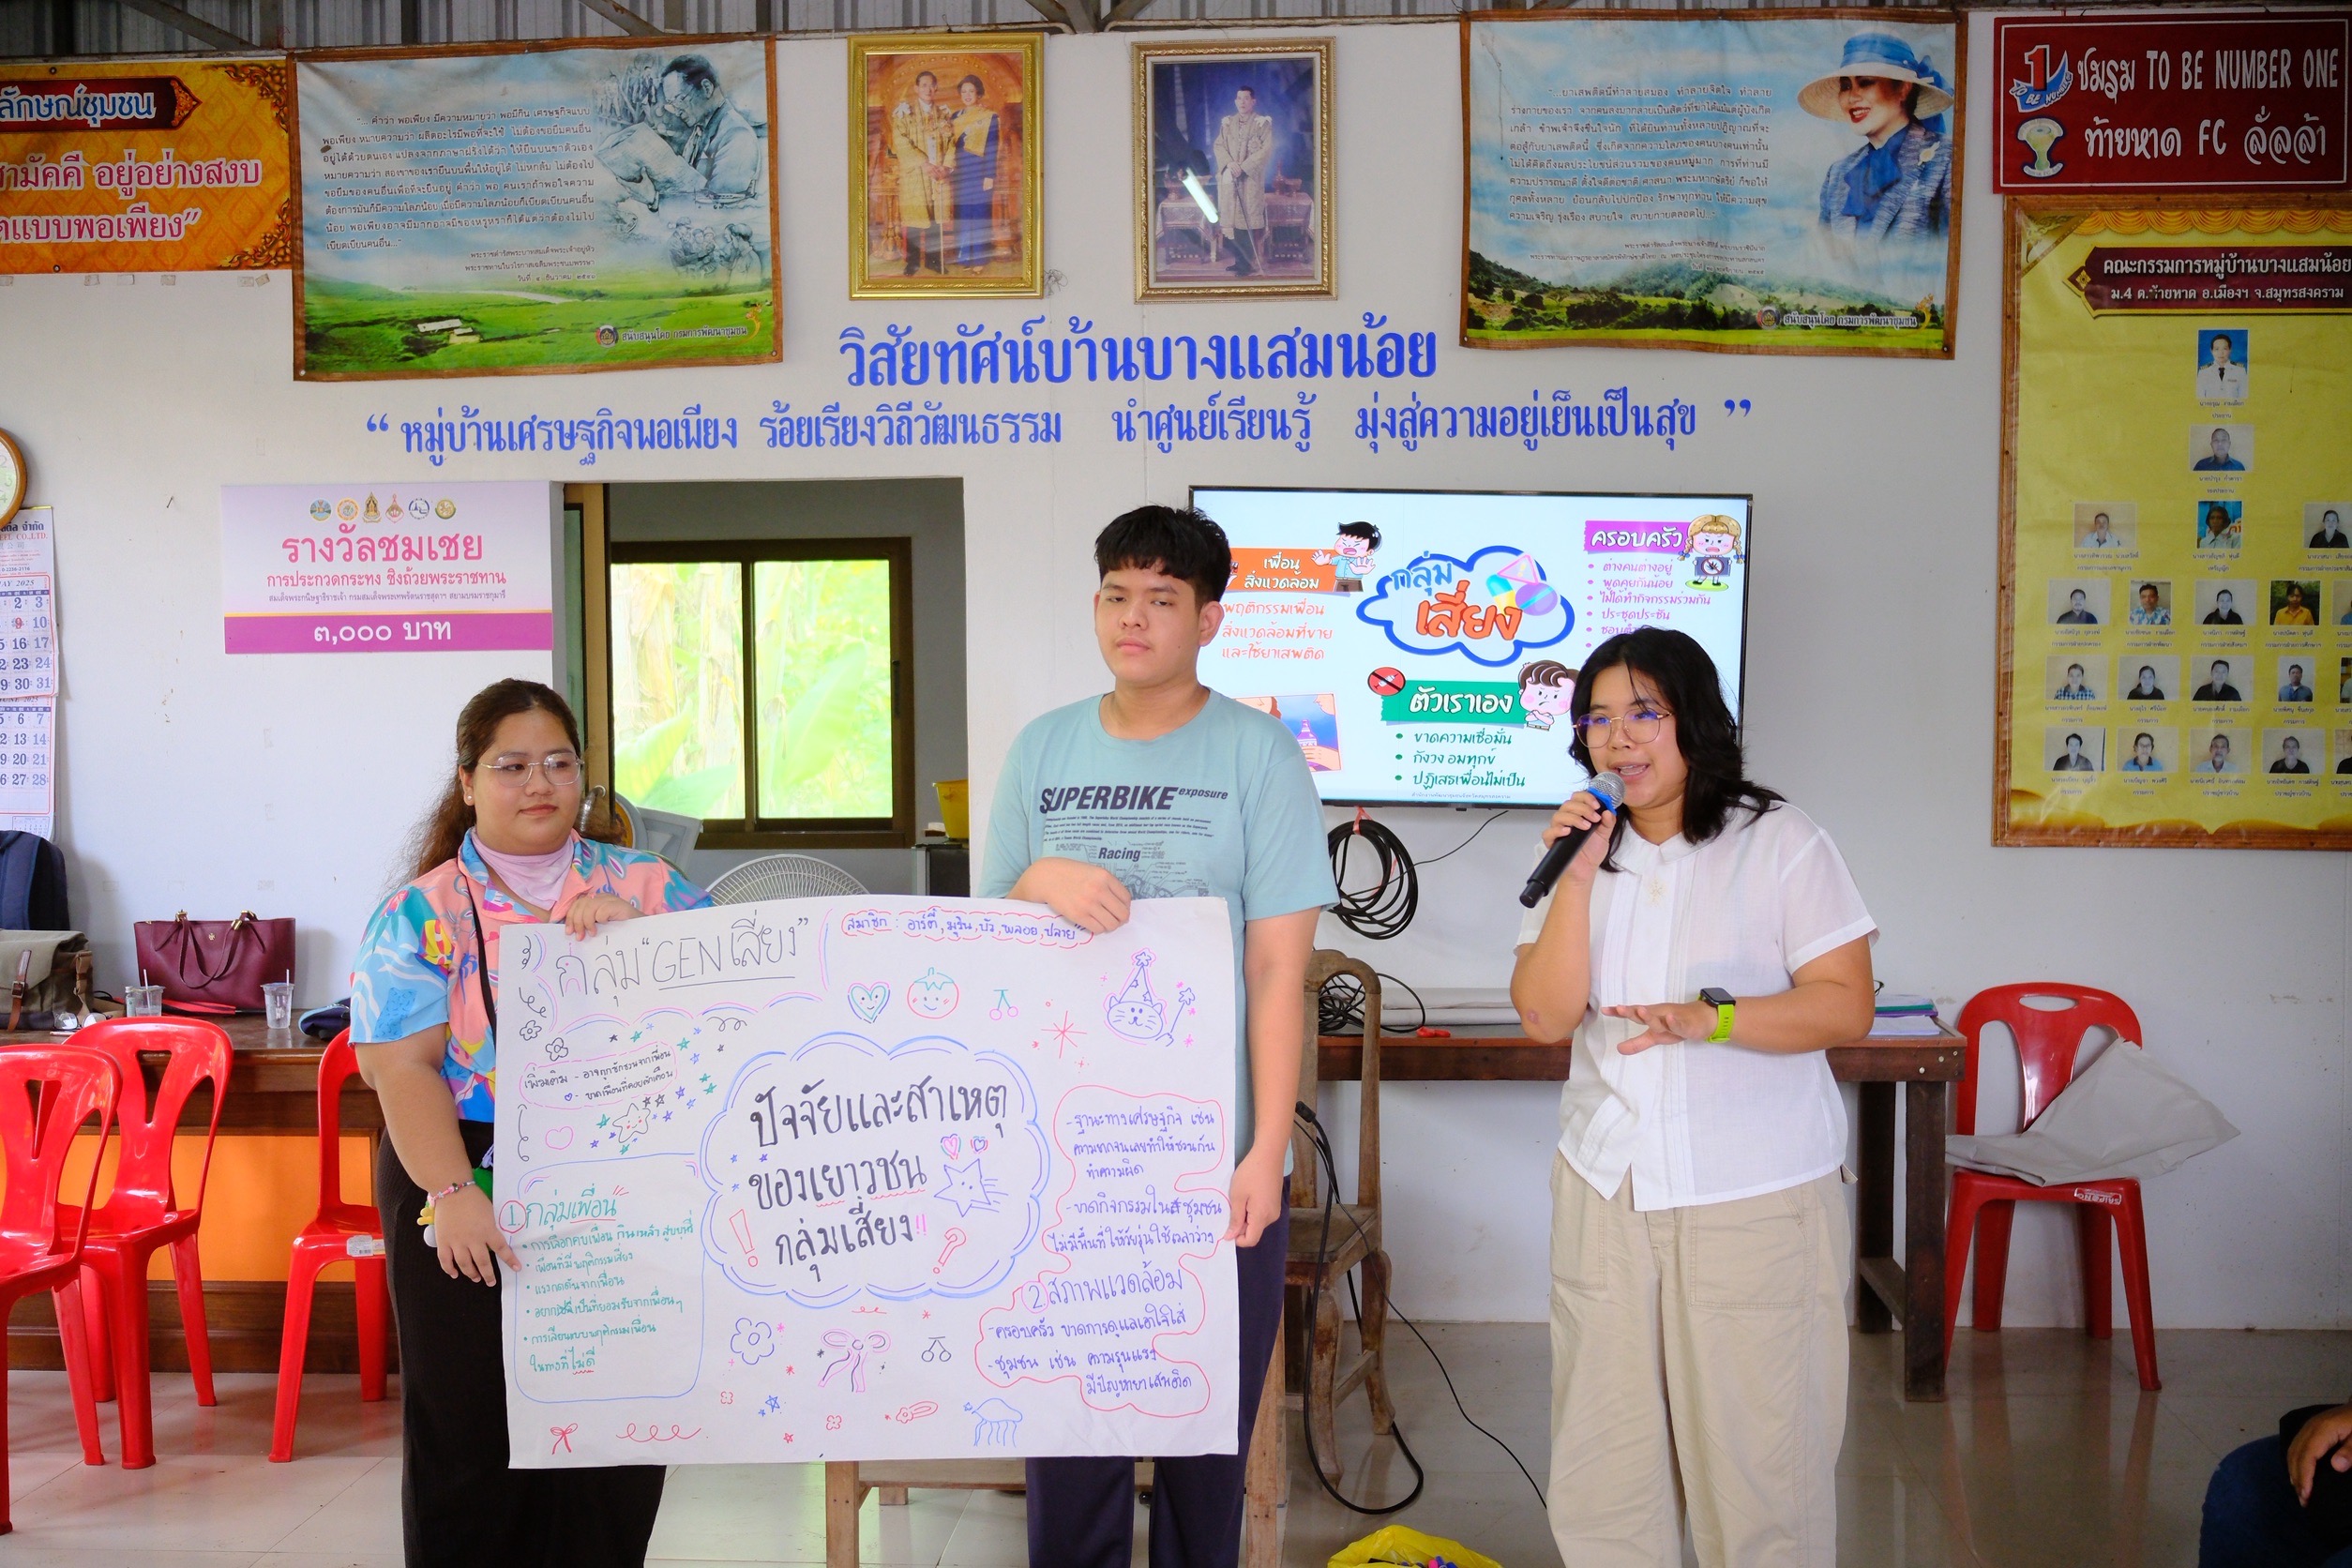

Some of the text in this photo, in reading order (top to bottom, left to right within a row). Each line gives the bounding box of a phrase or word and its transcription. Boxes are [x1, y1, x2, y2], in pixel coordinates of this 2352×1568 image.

[2147, 51, 2169, 90] TO
[2182, 51, 2202, 89] BE
[2216, 49, 2291, 89] NUMBER
[2303, 49, 2338, 87] ONE
[398, 113, 430, 125] พอเพียง
[434, 112, 496, 123] มีความหมายว่า
[534, 107, 590, 119] เศรษฐกิจแบบ
[323, 134, 355, 144] พอเพียง
[359, 130, 414, 143] หมายความว่า
[2085, 116, 2181, 158] ท้ายหาด
[2199, 119, 2226, 156] FC
[97, 152, 260, 196] อยู่อย่างสงบ
[324, 169, 381, 180] หมายความว่า
[2103, 253, 2351, 279] คณะกรรมการหมู่บ้านบางแสมน้อย
[2111, 284, 2344, 302] ม.4 ต.้ายหาด อ.เมืองฯ จ.สมุทรสงคราม
[838, 313, 1436, 386] วิสัยทัศน์บ้านบางแสมน้อย
[400, 406, 738, 466] หมู่บ้านเศรษฐกิจพอเพียง
[759, 400, 1063, 450] ร้อยเรียงวิถีวัฒนธรรม
[1111, 392, 1317, 454] นำศูนย์เรียนรู้
[1354, 387, 1697, 454] มุ่งสู่ความอยู่เย็นเป็นสุข
[23, 520, 44, 532] จำกัด
[282, 522, 483, 563] รางวัลชมเชย
[1591, 526, 1682, 548] ครอบครัว
[1264, 551, 1300, 570] เพื่อน
[1603, 558, 1673, 576] ต่างคนต่างอยู่
[267, 566, 506, 587] การประกวดกระทง ชิงถ้วยพระราชทาน
[1244, 570, 1319, 589] สิ่งแวดล้อม
[1391, 550, 1453, 596] กลุ่ม
[1603, 575, 1673, 591] พูดคุยกันน้อย
[14, 596, 43, 610] 2 3
[449, 589, 505, 602] สยามบรมราชกุมารี
[1600, 590, 1711, 605] ไม่ได้ทำกิจกรรมร่วมกัน
[1224, 598, 1324, 616] พฤติกรรมเพื่อน
[1415, 580, 1523, 641] เสี่ยง
[15, 616, 48, 629] 9 10
[1222, 621, 1333, 639] สิ่งแวดล้อมที่ขาย
[314, 621, 451, 645] ๓,๐๐๐ บาท
[12, 637, 49, 650] 16 17
[1222, 641, 1324, 659] และใช้ยาเสพติด
[13, 656, 51, 670] 23 24
[15, 677, 51, 690] 30 31
[1410, 686, 1513, 714] ตัวเราเอง
[14, 733, 27, 745] 13
[1414, 728, 1512, 745] ขาดความเชื่อมั่น
[12, 753, 27, 765] 20
[1448, 748, 1497, 769] อมทุกข์
[12, 774, 46, 786] 27 28
[1413, 770, 1525, 790] ปฏิเสธเพื่อนไม่เป็น
[1039, 786, 1229, 814] SUPERBIKE exposure
[1098, 847, 1141, 862] Racing
[847, 912, 887, 930] สมาชิก
[555, 935, 641, 1007] กลุ่ม
[749, 1076, 1008, 1147] ปัจจัยและสาเหตุ
[1074, 1106, 1214, 1136] ฐานะทางเศรษฐกิจ เช่น
[1086, 1158, 1144, 1180] ทำความผิด
[748, 1150, 928, 1210] ของเยาวชน
[526, 1184, 617, 1230] กลุ่มเพื่อน
[531, 1223, 613, 1251] การเลือกคบเพื่อน
[617, 1224, 660, 1240] กินเหล้า
[535, 1270, 626, 1295] แรงกดดันจากเพื่อน
[1048, 1260, 1183, 1304] สภาพแวดล้อม
[995, 1303, 1186, 1339] ครอบครัว ขาดการดูแลเอาใจใส่
[994, 1349, 1157, 1380] ชุมชน เช่น ความรุนแรง
